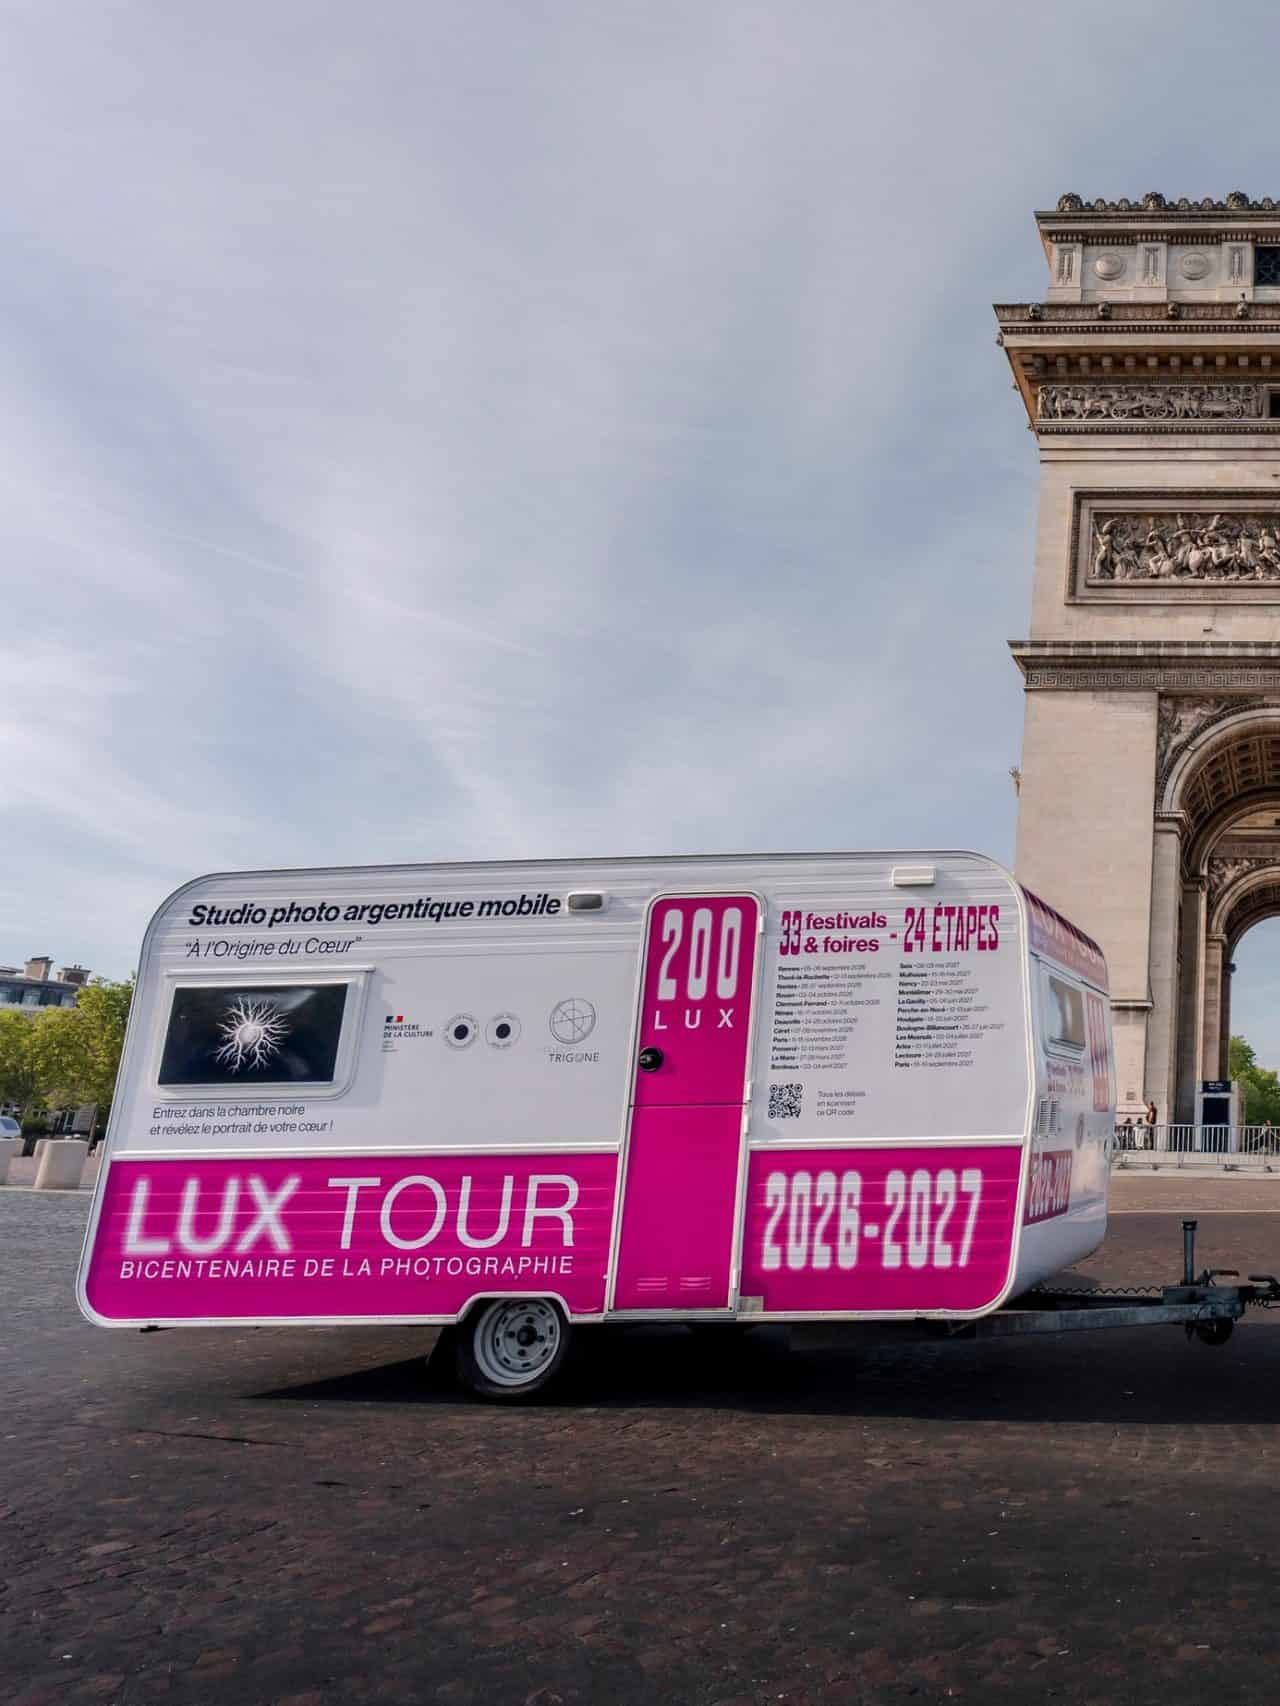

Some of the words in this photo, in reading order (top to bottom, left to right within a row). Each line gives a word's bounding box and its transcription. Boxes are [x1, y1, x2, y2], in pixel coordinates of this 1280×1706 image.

[189, 903, 266, 926] Studio
[268, 902, 340, 928] photo
[344, 897, 474, 925] argentique
[477, 894, 561, 917] mobile
[780, 910, 802, 956] 33
[806, 911, 887, 930] festivals
[903, 907, 925, 952] 24
[932, 902, 999, 952] ÉTAPES
[278, 939, 300, 956] du
[657, 907, 742, 1001] 200
[804, 937, 818, 953] &
[822, 936, 880, 953] foires
[404, 1030, 433, 1038] CULTURE
[153, 1106, 187, 1119] Entrez
[188, 1106, 215, 1118] dans
[217, 1106, 227, 1117] la
[228, 1105, 276, 1117] chambre
[278, 1104, 305, 1116] noire
[150, 1125, 161, 1135] et
[201, 1123, 211, 1134] le
[212, 1122, 251, 1136] portrait
[253, 1121, 268, 1133] de
[270, 1121, 296, 1132] votre
[123, 1175, 302, 1255] LUX
[328, 1174, 579, 1250] TOUR
[761, 1169, 982, 1270] 2026-2027
[120, 1259, 296, 1279] BICENTENAIRE
[304, 1259, 335, 1277] DE
[343, 1258, 371, 1276] LA
[381, 1256, 573, 1276] PHOTOGRAPHIE
